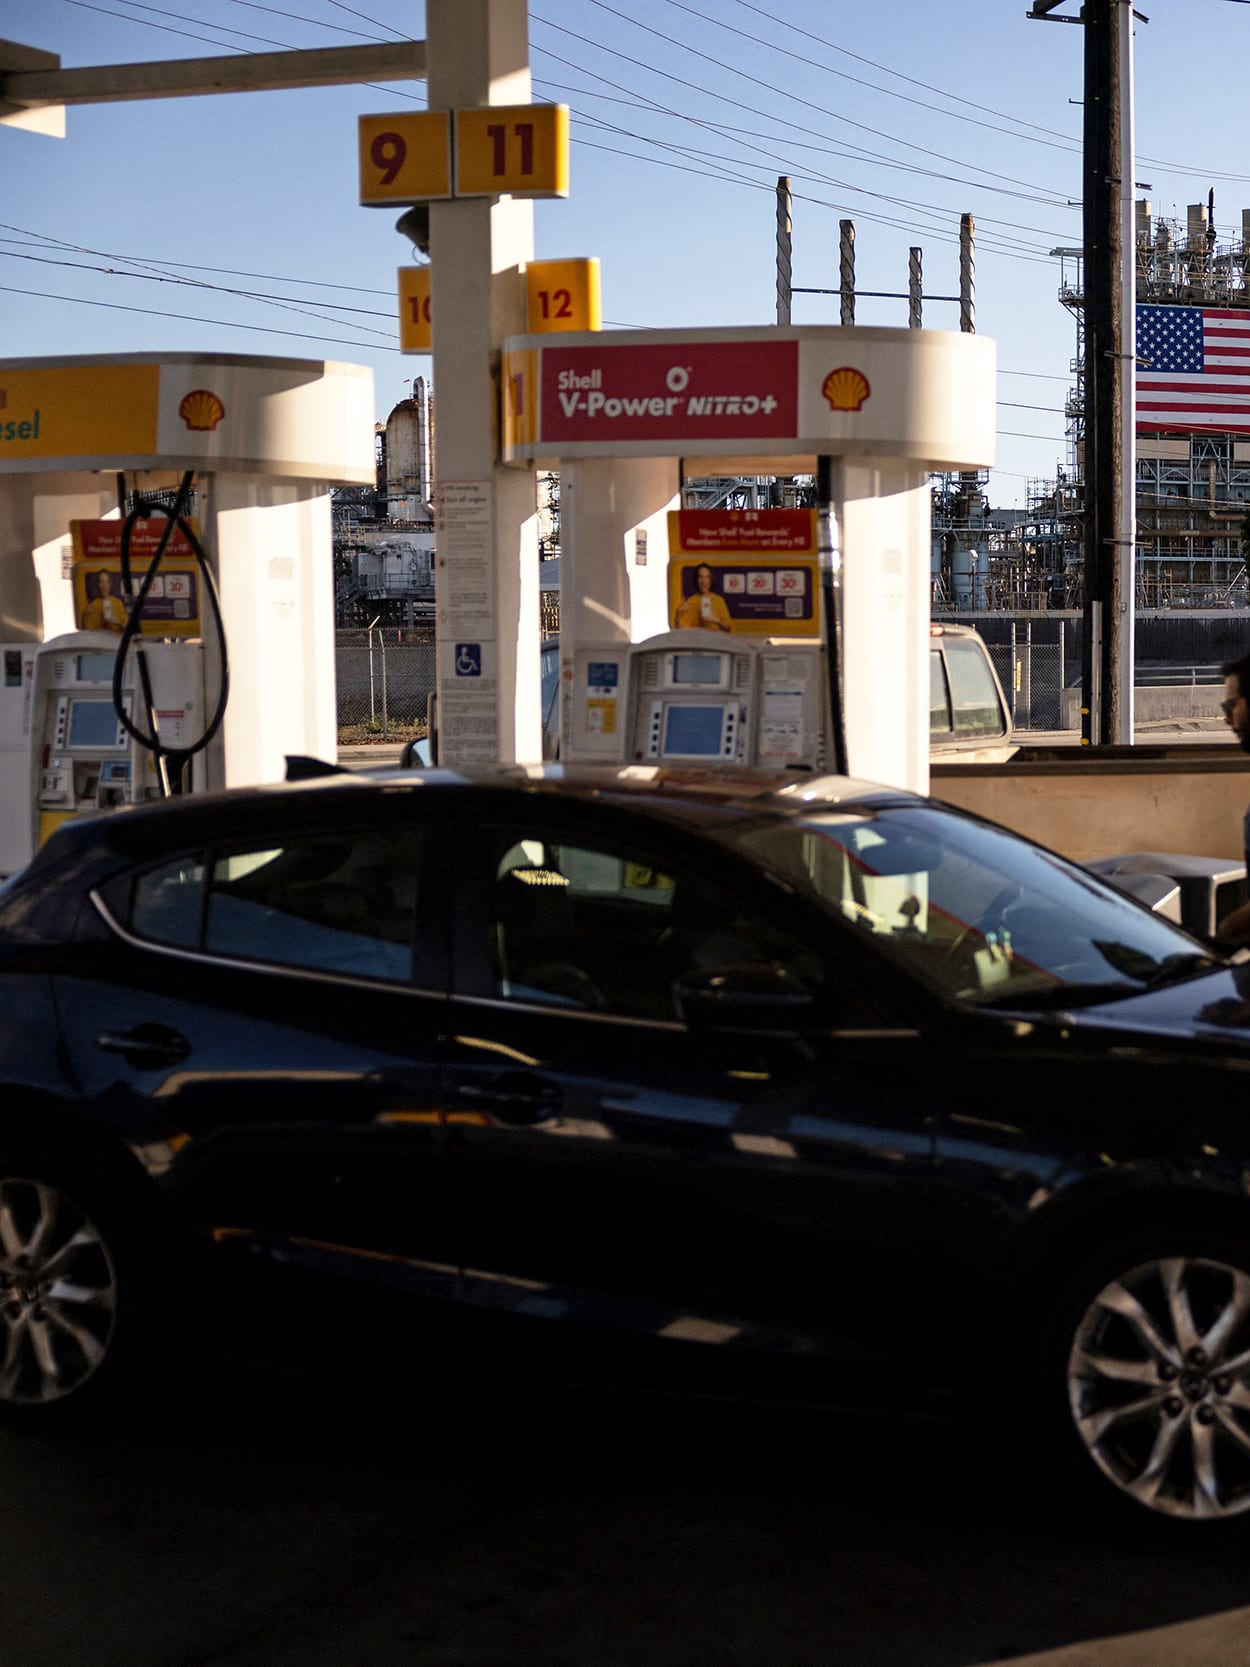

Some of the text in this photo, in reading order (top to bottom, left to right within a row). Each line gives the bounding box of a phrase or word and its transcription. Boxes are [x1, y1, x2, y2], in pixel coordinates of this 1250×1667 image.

[371, 132, 407, 185] 9
[487, 123, 534, 176] 11
[538, 289, 572, 319] 12
[558, 369, 601, 390] Shell
[558, 391, 676, 418] V-Power
[0, 408, 40, 440] sel
